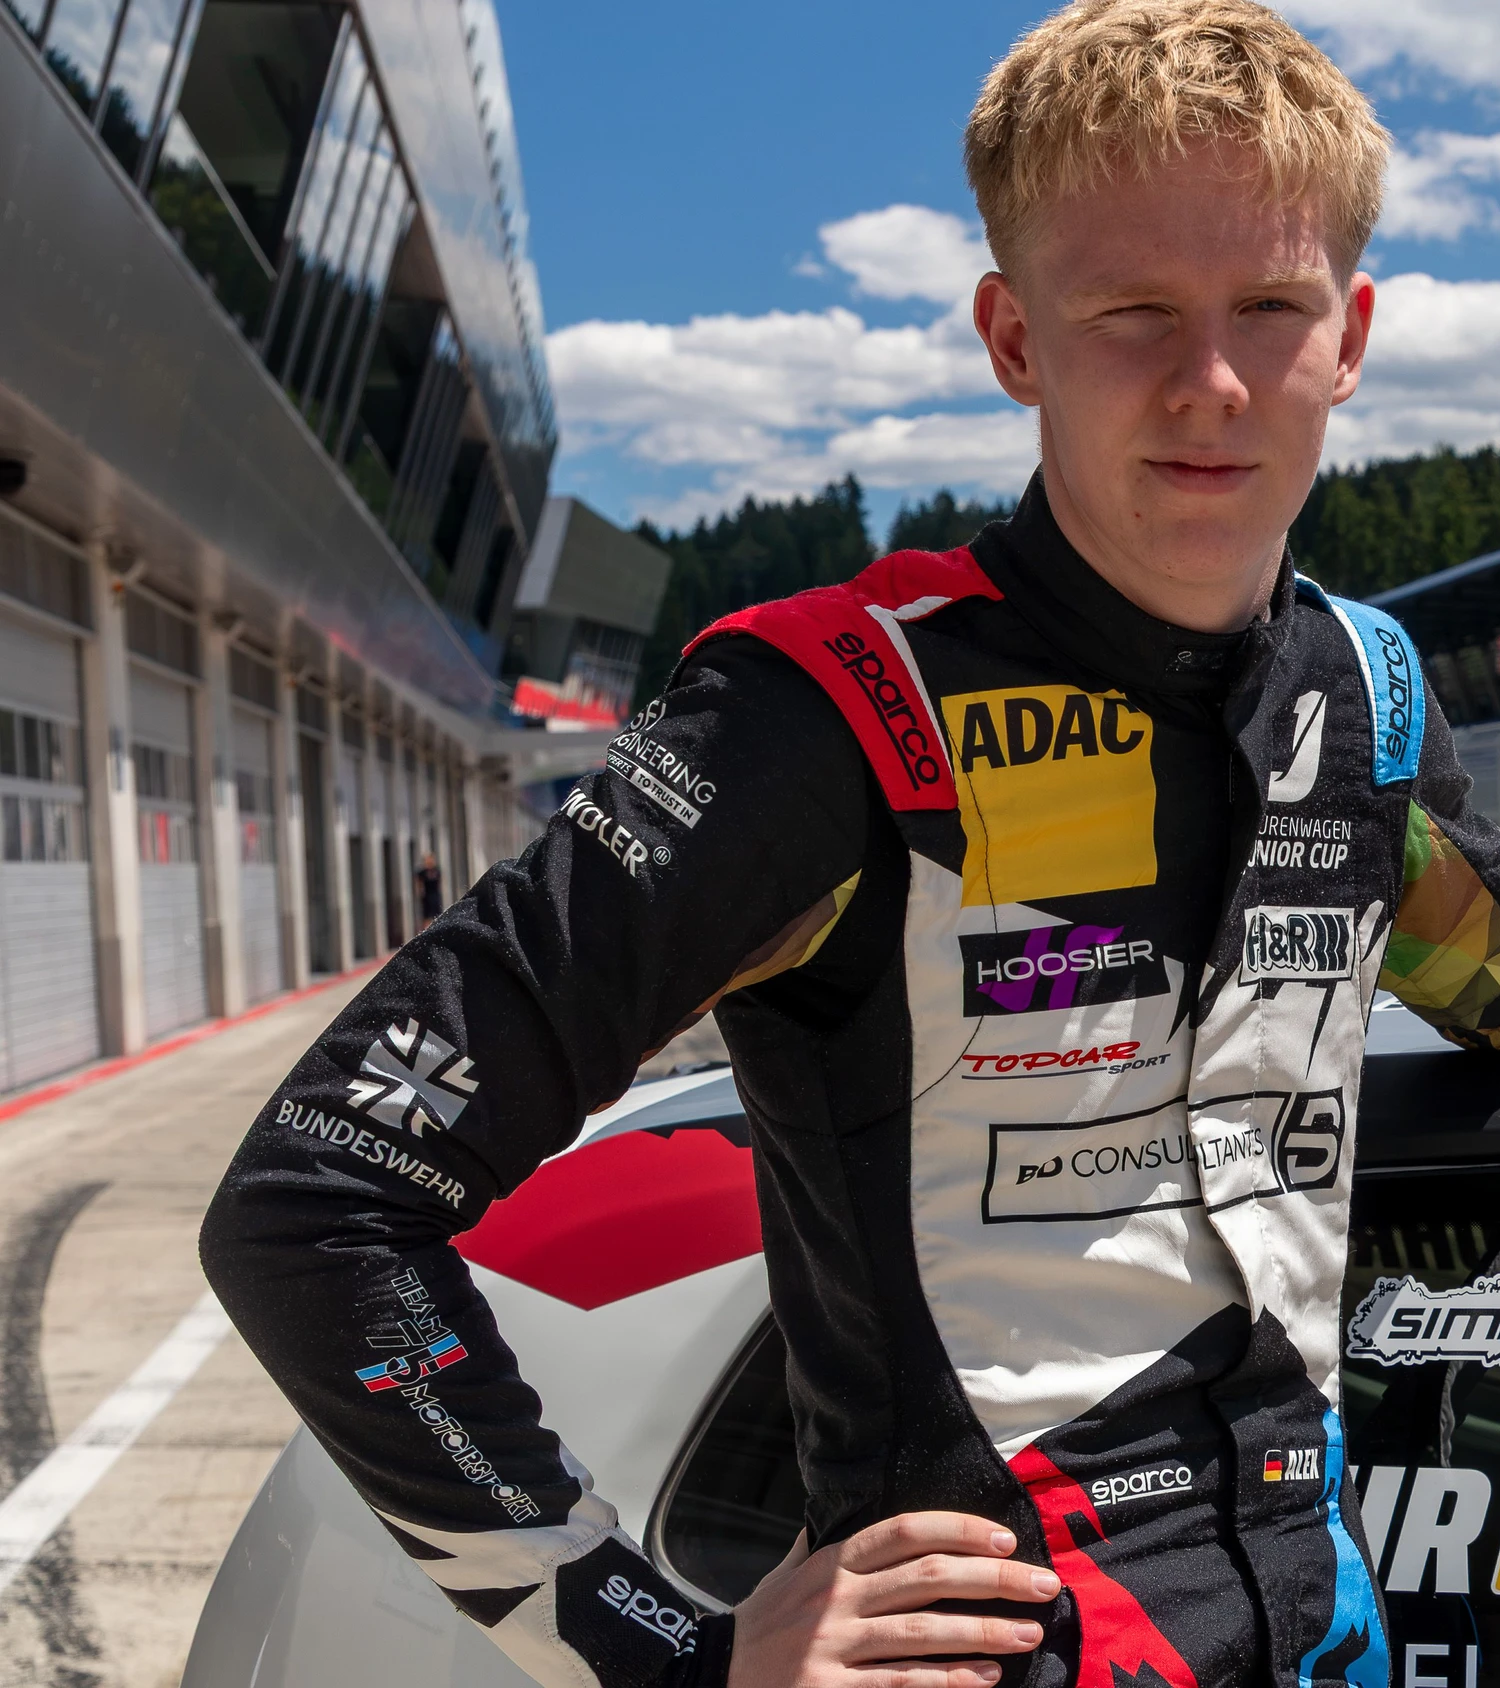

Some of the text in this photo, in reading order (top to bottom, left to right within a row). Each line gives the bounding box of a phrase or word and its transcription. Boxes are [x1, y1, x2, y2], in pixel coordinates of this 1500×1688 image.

[822, 632, 939, 791] sparco
[961, 693, 1145, 773] ADAC
[1375, 627, 1413, 765] sparco
[637, 774, 695, 821] TO TRUST IN
[1309, 842, 1348, 869] CUP
[976, 939, 1155, 985] HOOSIER
[1246, 912, 1318, 972] H&R
[962, 1041, 1171, 1075] TOPCAR SPORT
[275, 1099, 466, 1209] BUNDESWEHR
[390, 1266, 452, 1342] TEAM
[400, 1382, 541, 1524] MOTORSPORT
[1091, 1466, 1193, 1507] sparco
[597, 1574, 699, 1657] spar
